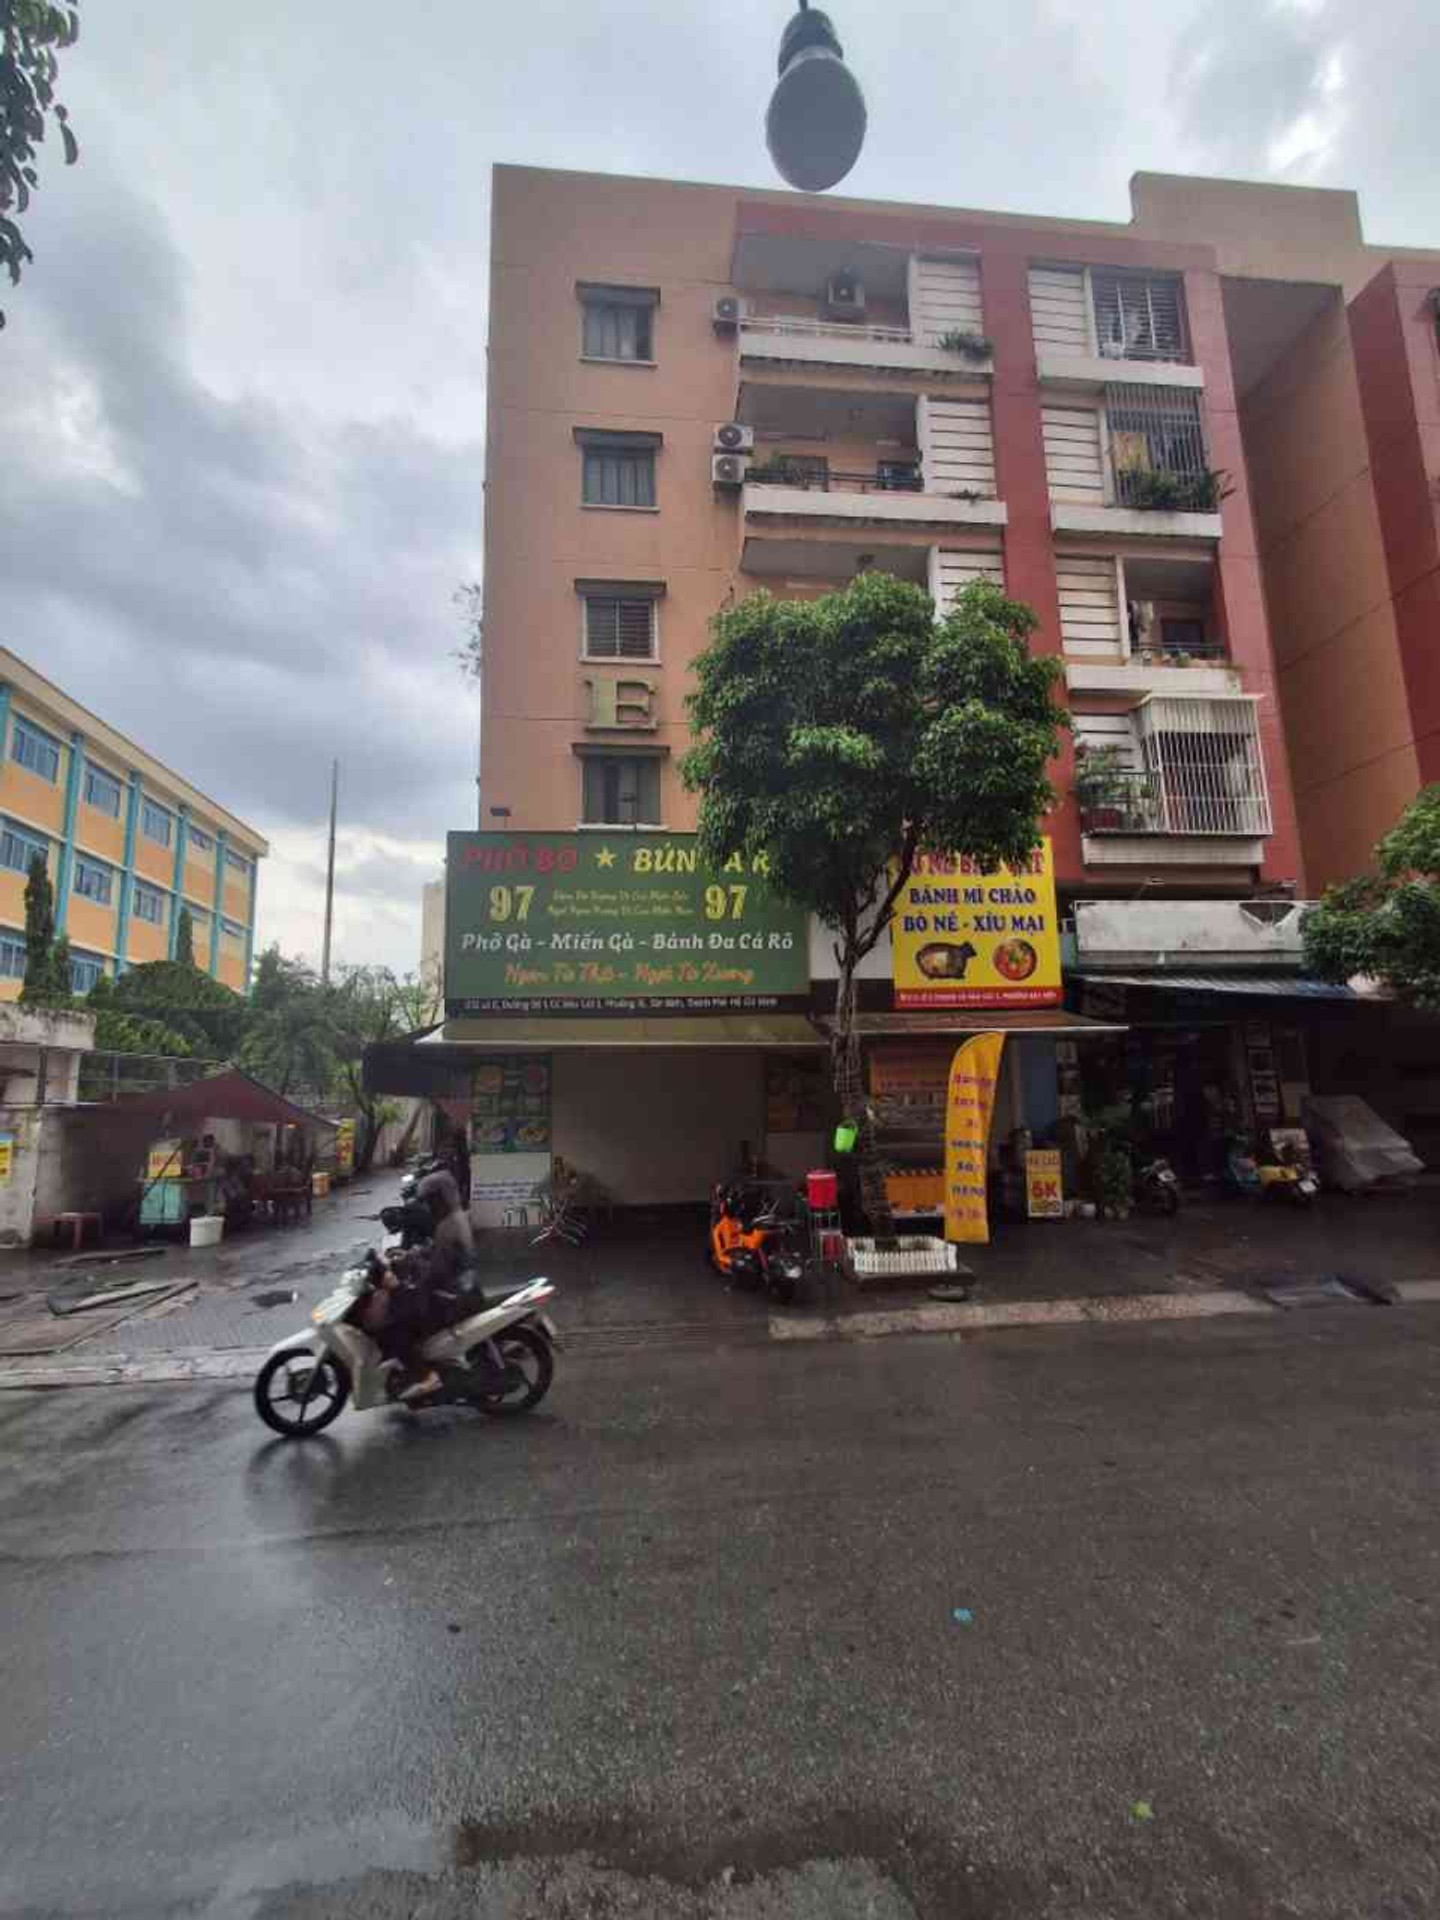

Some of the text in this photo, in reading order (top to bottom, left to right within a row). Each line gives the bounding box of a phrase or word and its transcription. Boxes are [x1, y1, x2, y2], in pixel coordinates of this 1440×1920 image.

[633, 840, 697, 873] BÚN
[489, 885, 535, 922] 97
[705, 884, 747, 920] 97
[909, 884, 959, 904] BÁNH
[974, 912, 1007, 932] XÍU
[1011, 914, 1044, 936] MẠI
[461, 932, 501, 950] Phở
[506, 931, 532, 953] Gà
[551, 930, 603, 950] Miến
[609, 931, 635, 953] Gà
[652, 931, 703, 950] Bánh
[708, 932, 734, 950] Đa
[739, 930, 763, 950] Cá
